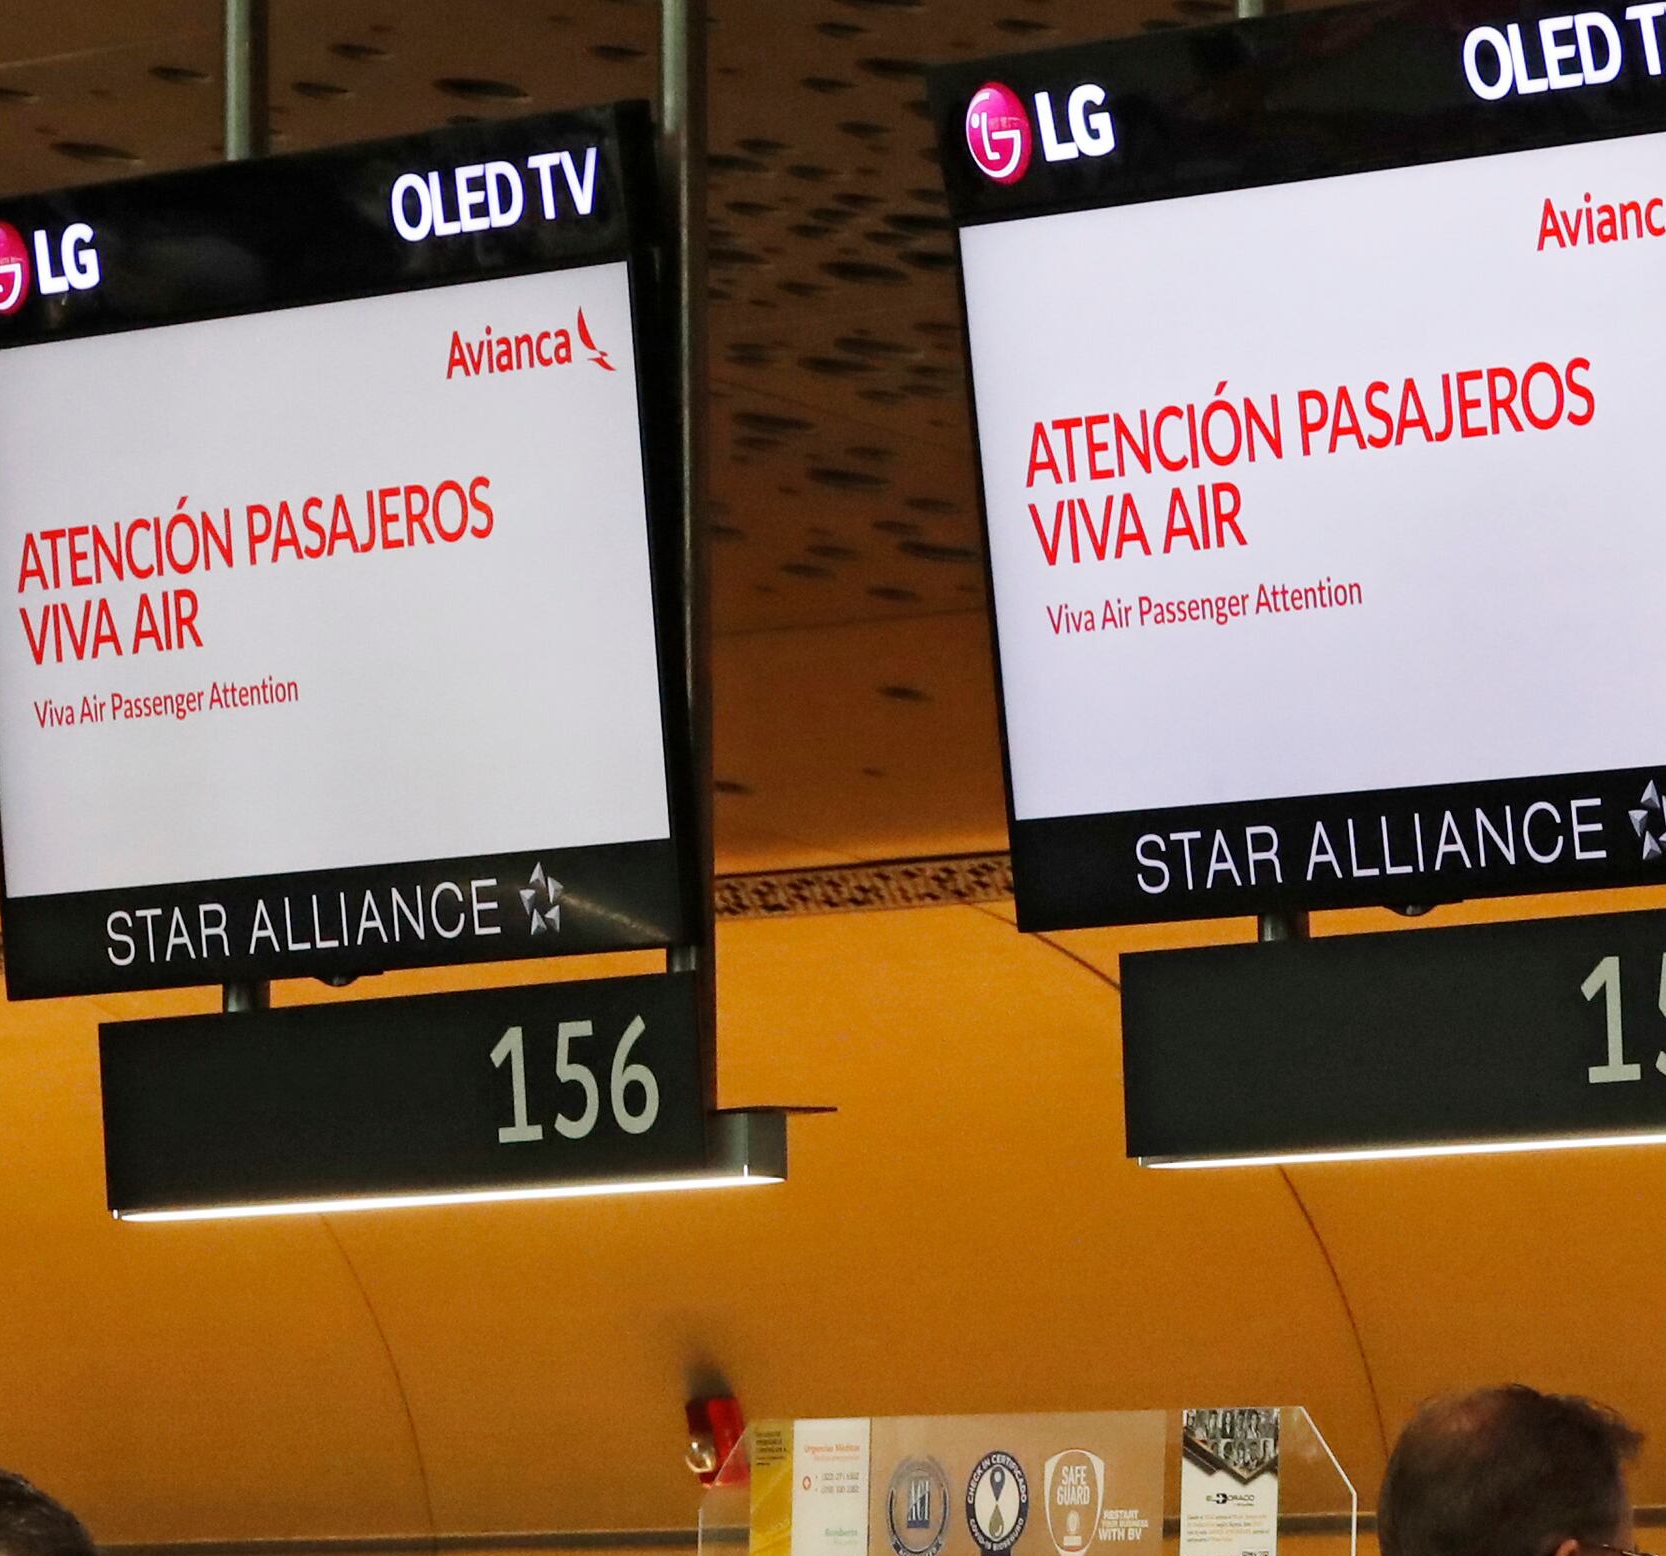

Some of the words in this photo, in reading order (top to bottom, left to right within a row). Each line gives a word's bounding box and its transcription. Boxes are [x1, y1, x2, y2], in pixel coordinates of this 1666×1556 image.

[1463, 12, 1621, 100] OLED
[1035, 84, 1115, 161] LG
[392, 161, 523, 241] OLED
[528, 147, 596, 219] TV
[34, 223, 99, 294] LG
[447, 326, 573, 379] Avianca
[1026, 380, 1283, 488] ATENCIÓN
[1298, 357, 1595, 457] PASAJEROS
[18, 496, 234, 593] ATENCIÓN
[246, 476, 494, 566] PASAJEROS
[1028, 492, 1152, 567] VIVA
[1163, 482, 1248, 554] AIR
[19, 598, 123, 666] VIVA
[133, 588, 203, 655] AIR
[1047, 602, 1097, 636] Viva
[1102, 600, 1133, 631] Air
[1138, 591, 1250, 630] Passenger
[1256, 576, 1362, 615] Attention
[35, 699, 75, 729] Viva
[79, 697, 107, 724] Air
[112, 689, 204, 724] Passenger
[209, 677, 299, 710] Attention
[1136, 826, 1282, 893] STAR
[1307, 798, 1606, 880] ALLIANCE
[107, 904, 229, 965] STAR
[250, 879, 501, 954] ALLIANCE
[491, 1016, 658, 1142] 156
[1056, 1485, 1090, 1506] GUARD
[1061, 1465, 1087, 1486] SAFE
[1098, 1528, 1125, 1541] WITH
[1126, 1527, 1142, 1541] BV
